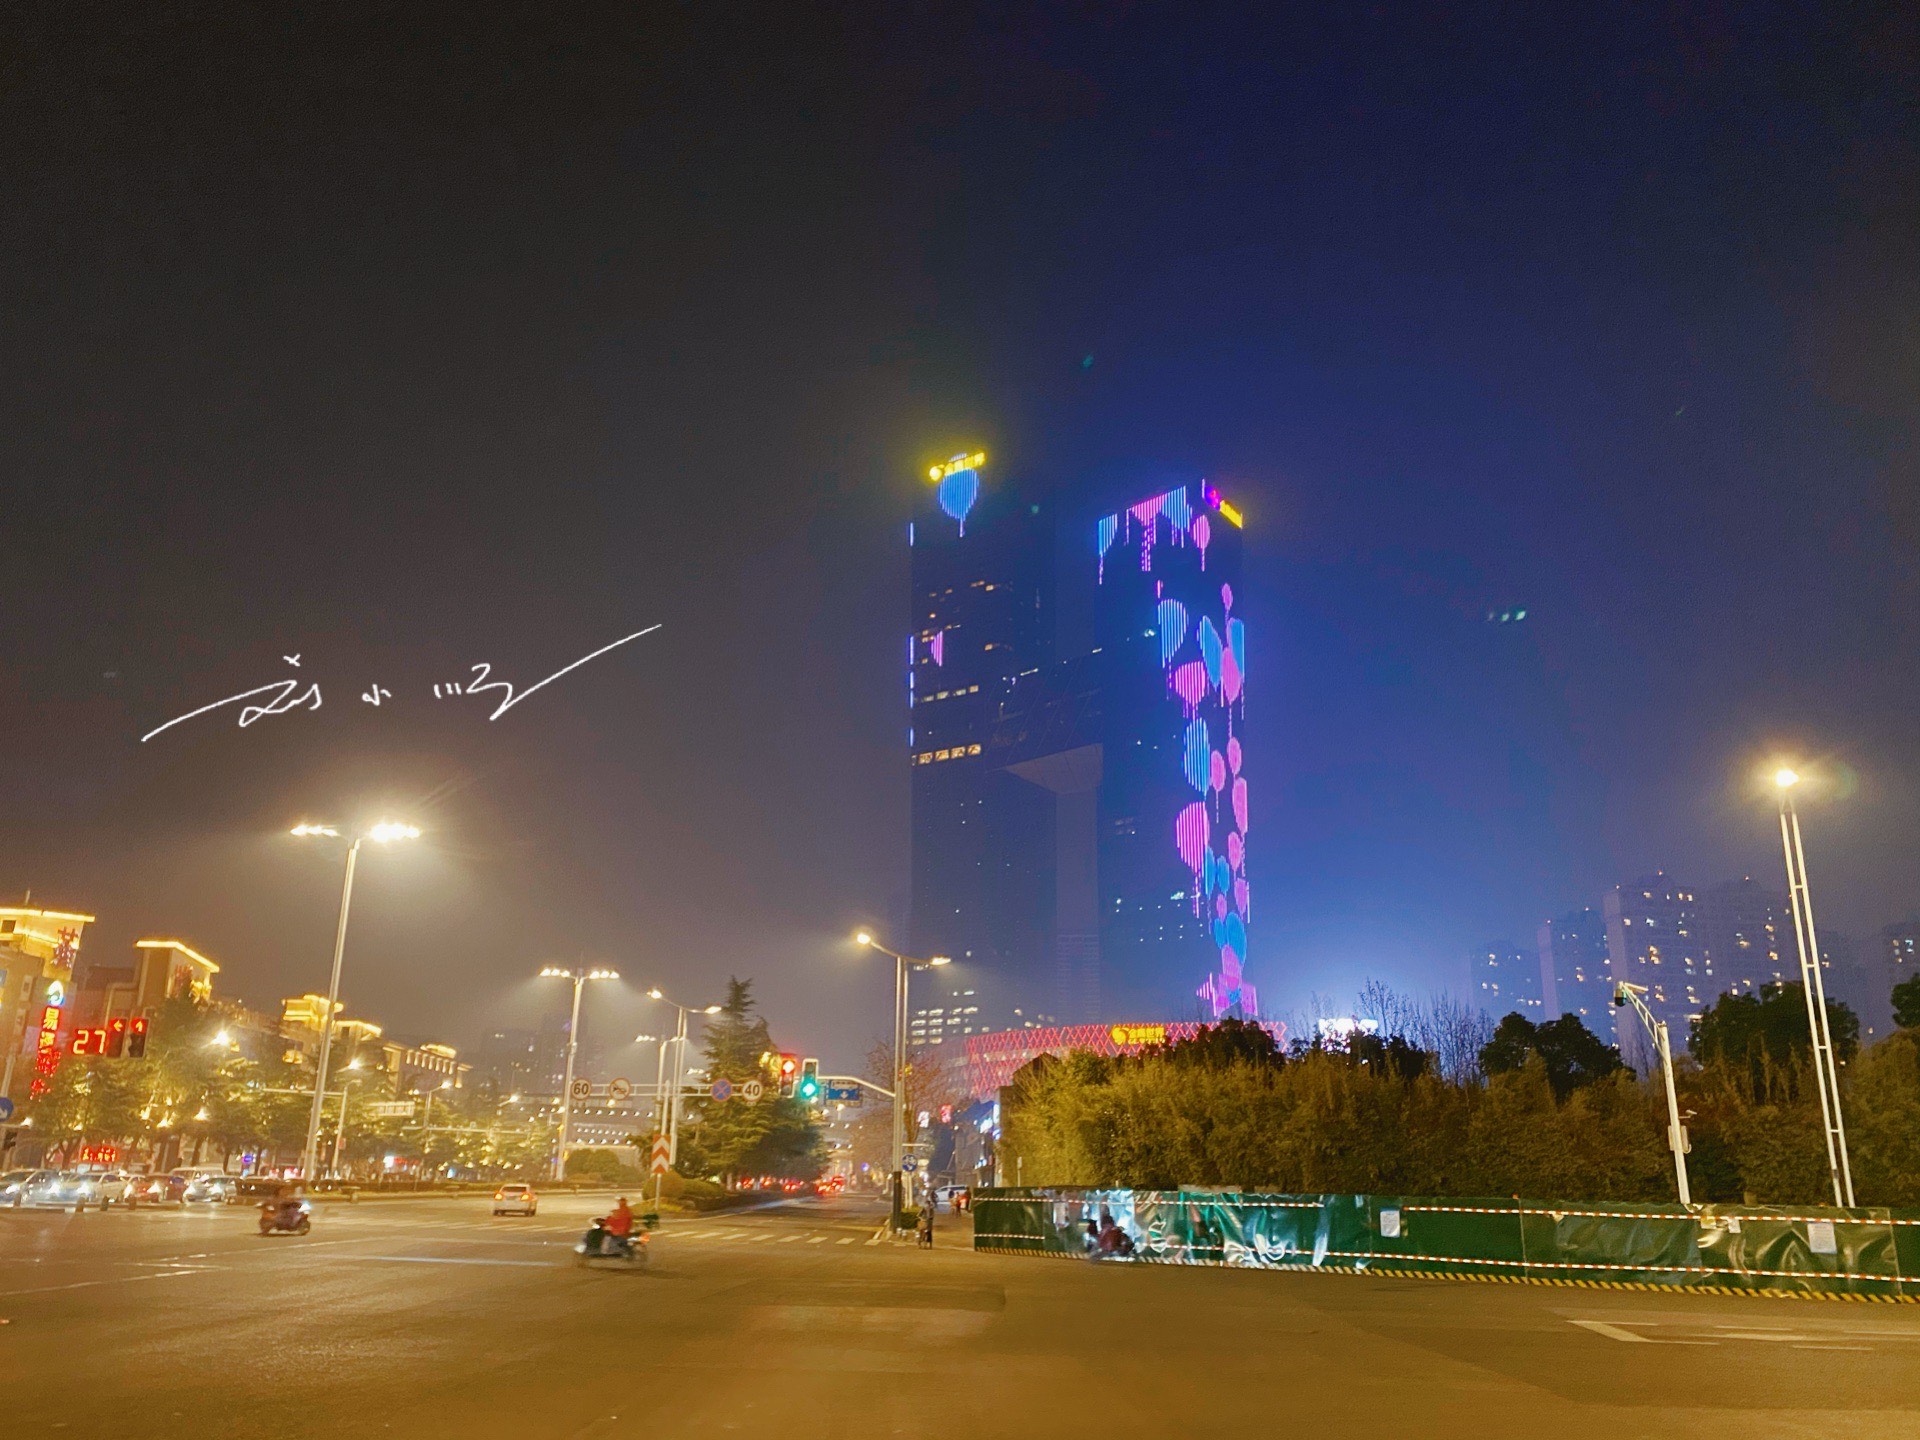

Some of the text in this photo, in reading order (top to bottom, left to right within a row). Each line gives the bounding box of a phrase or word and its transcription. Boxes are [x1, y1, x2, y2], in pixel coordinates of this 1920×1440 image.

[72, 1029, 107, 1055] 27
[573, 1082, 589, 1096] 60
[744, 1083, 760, 1097] 40
